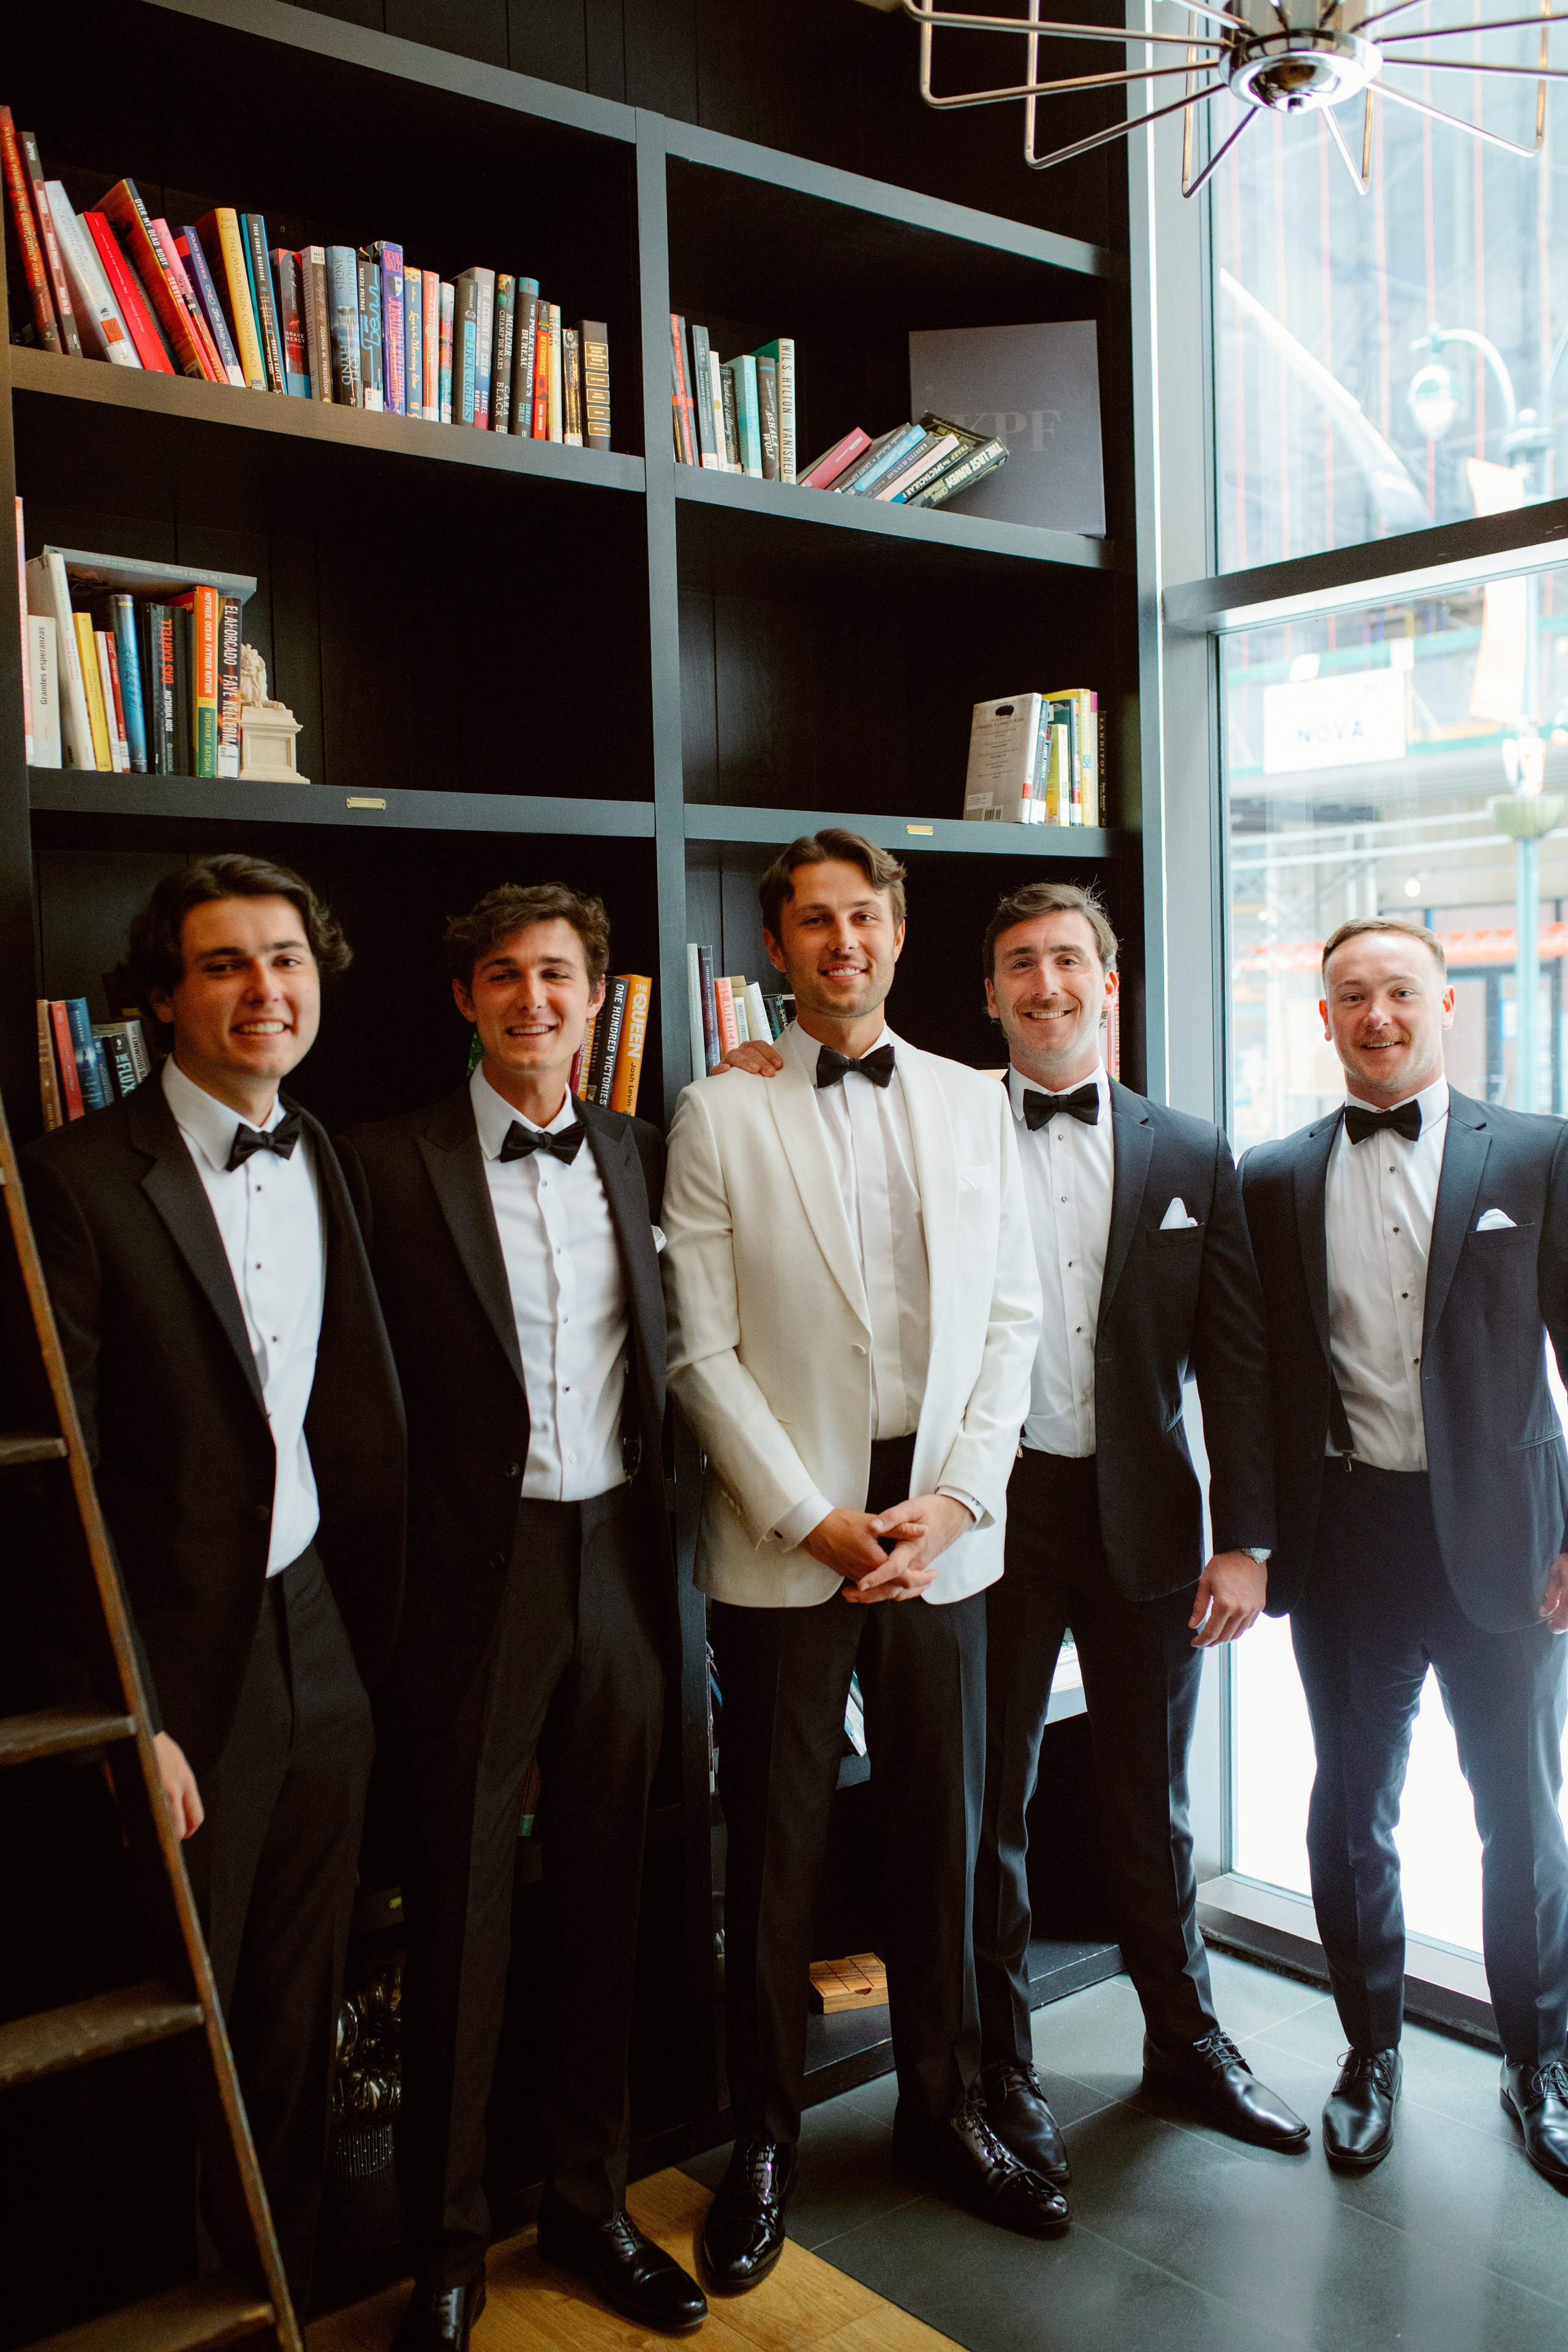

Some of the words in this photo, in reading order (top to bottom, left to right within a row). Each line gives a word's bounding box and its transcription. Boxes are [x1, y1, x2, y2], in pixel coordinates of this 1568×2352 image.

[26, 141, 36, 161] Jarrow
[37, 190, 48, 214] MADNESS
[17, 197, 26, 212] THE
[26, 236, 37, 262] COMET
[47, 233, 57, 251] Medical
[56, 208, 75, 246] LAWSON
[73, 247, 88, 273] ROBY
[67, 217, 89, 262] KIMBERLA
[135, 198, 148, 216] OVER
[142, 217, 152, 228] MY
[147, 229, 160, 247] DEAD
[156, 248, 169, 266] BODY
[167, 276, 184, 303] SERVER
[228, 236, 238, 254] THE
[50, 251, 60, 269] Mystery
[256, 255, 266, 282] MARRIAGE
[334, 257, 345, 290] ANGELS
[385, 261, 404, 273] WALTZ
[59, 287, 68, 298] What
[178, 274, 193, 301] Maddie
[189, 230, 198, 252] JOJO
[195, 253, 208, 279] MOYES
[216, 323, 225, 341] Ship
[222, 342, 230, 350] of
[232, 256, 247, 311] MARATHON
[481, 284, 491, 299] THE
[61, 298, 69, 307] We
[388, 296, 404, 347] JONATHAN
[481, 301, 491, 336] ACCIDENT
[549, 316, 560, 347] HACK
[242, 314, 258, 369] CONSPIRACY
[481, 339, 489, 351] OF
[497, 338, 505, 349] DE
[504, 312, 514, 357] MURDER
[321, 351, 326, 360] M.
[409, 338, 420, 371] Morning
[465, 338, 473, 371] LUCK
[520, 328, 529, 369] BUREAU
[526, 318, 536, 398] POLICEWOMEN'S
[539, 334, 548, 376] AFTERSHOCKS
[781, 344, 792, 362] WIL
[340, 345, 352, 386] HYND
[390, 346, 405, 404] KELLERMAN
[480, 353, 489, 378] COLOR
[411, 372, 420, 390] Star
[464, 374, 474, 419] UGLIES
[494, 381, 504, 418] BLACK
[782, 377, 793, 414] HYLTON
[725, 407, 734, 435] calling
[765, 409, 778, 447] ASHALA
[762, 432, 775, 461] WOLF
[782, 428, 794, 475] VANISHED
[910, 442, 929, 462] KRISTIN
[951, 443, 970, 461] THARP
[988, 441, 1005, 456] THE
[858, 461, 872, 476] LIGHT
[886, 460, 909, 481] HANNAH
[905, 462, 946, 497] SPECTACULAR
[944, 462, 973, 489] RAVEN
[164, 565, 187, 576] Lining
[189, 570, 209, 581] Silver
[204, 592, 213, 619] MOTHER
[224, 605, 239, 616] EL
[160, 618, 173, 662] KARTELL
[204, 621, 213, 642] OCEAN
[223, 616, 238, 666] AHORCADO
[38, 626, 48, 671] esperanzas
[204, 644, 213, 669] FATHER
[162, 664, 174, 684] DAS
[204, 671, 213, 694] NATION
[223, 674, 238, 698] FAYE
[40, 673, 48, 705] Grandes
[164, 690, 173, 718] WINSLOW
[165, 719, 174, 732] DON
[222, 700, 238, 748] KELLERMA
[1297, 720, 1365, 744] NOVA
[613, 983, 625, 1004] ONE
[635, 982, 649, 993] THE
[606, 1005, 622, 1053] HUNDRED
[627, 992, 649, 1059] QUEEN
[115, 1052, 129, 1063] THE
[131, 1036, 145, 1073] LINWOOD
[117, 1060, 137, 1096] FLUX
[598, 1055, 616, 1106] VICTORIES
[628, 1062, 637, 1083] Josh
[626, 1085, 636, 1107] Levin
